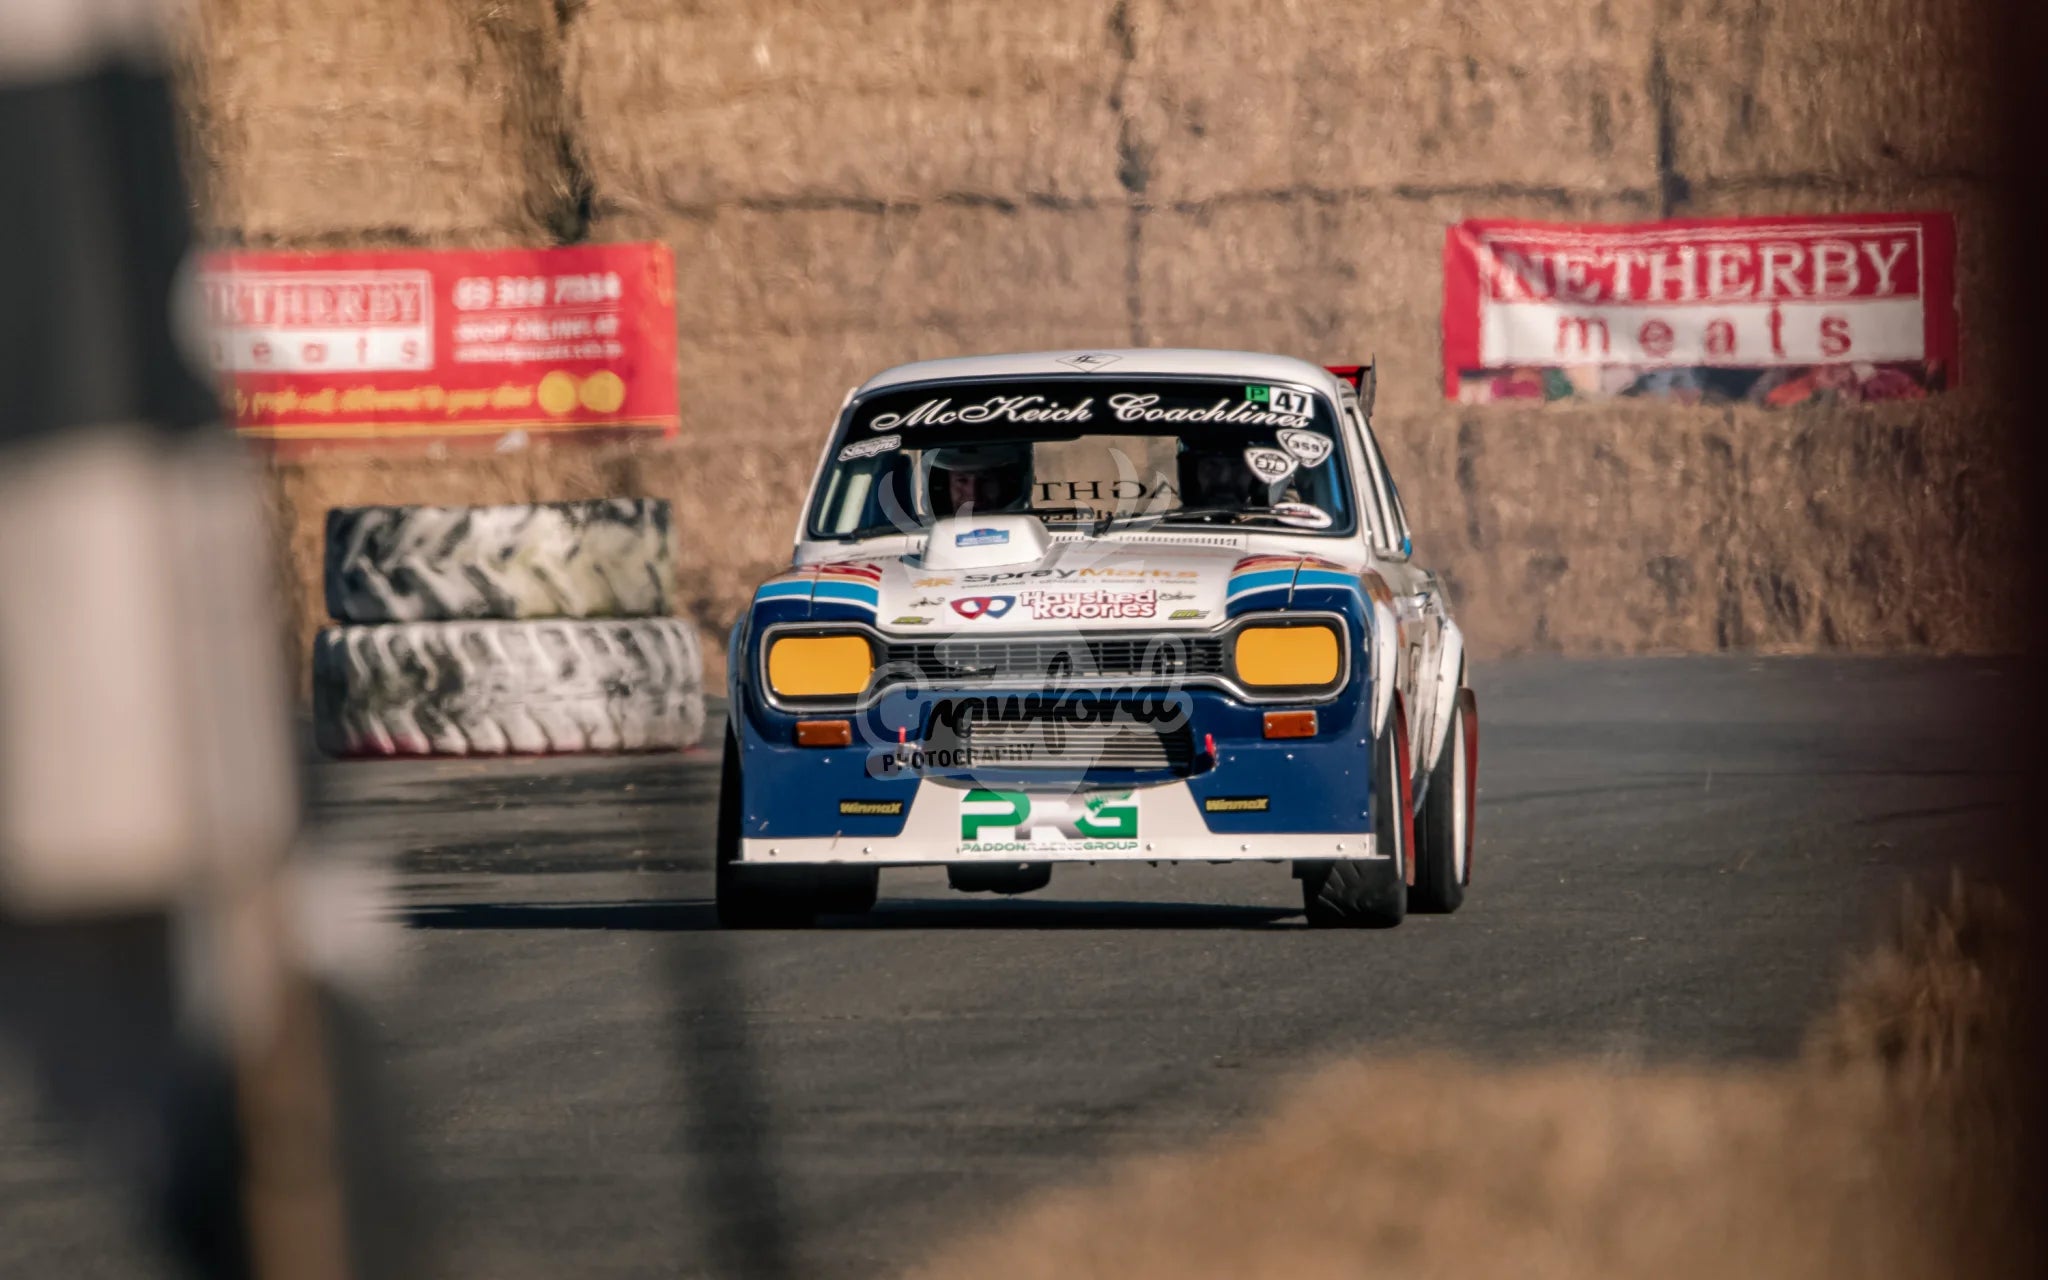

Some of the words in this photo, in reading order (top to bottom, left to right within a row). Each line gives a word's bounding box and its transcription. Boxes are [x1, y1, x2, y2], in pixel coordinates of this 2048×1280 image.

[1500, 241, 1909, 302] NETHERBY
[1557, 298, 1852, 360] meats
[870, 395, 1093, 431] McKeich
[1108, 393, 1310, 428] Coachlines
[1275, 391, 1307, 415] 47
[961, 788, 1138, 840] PRG
